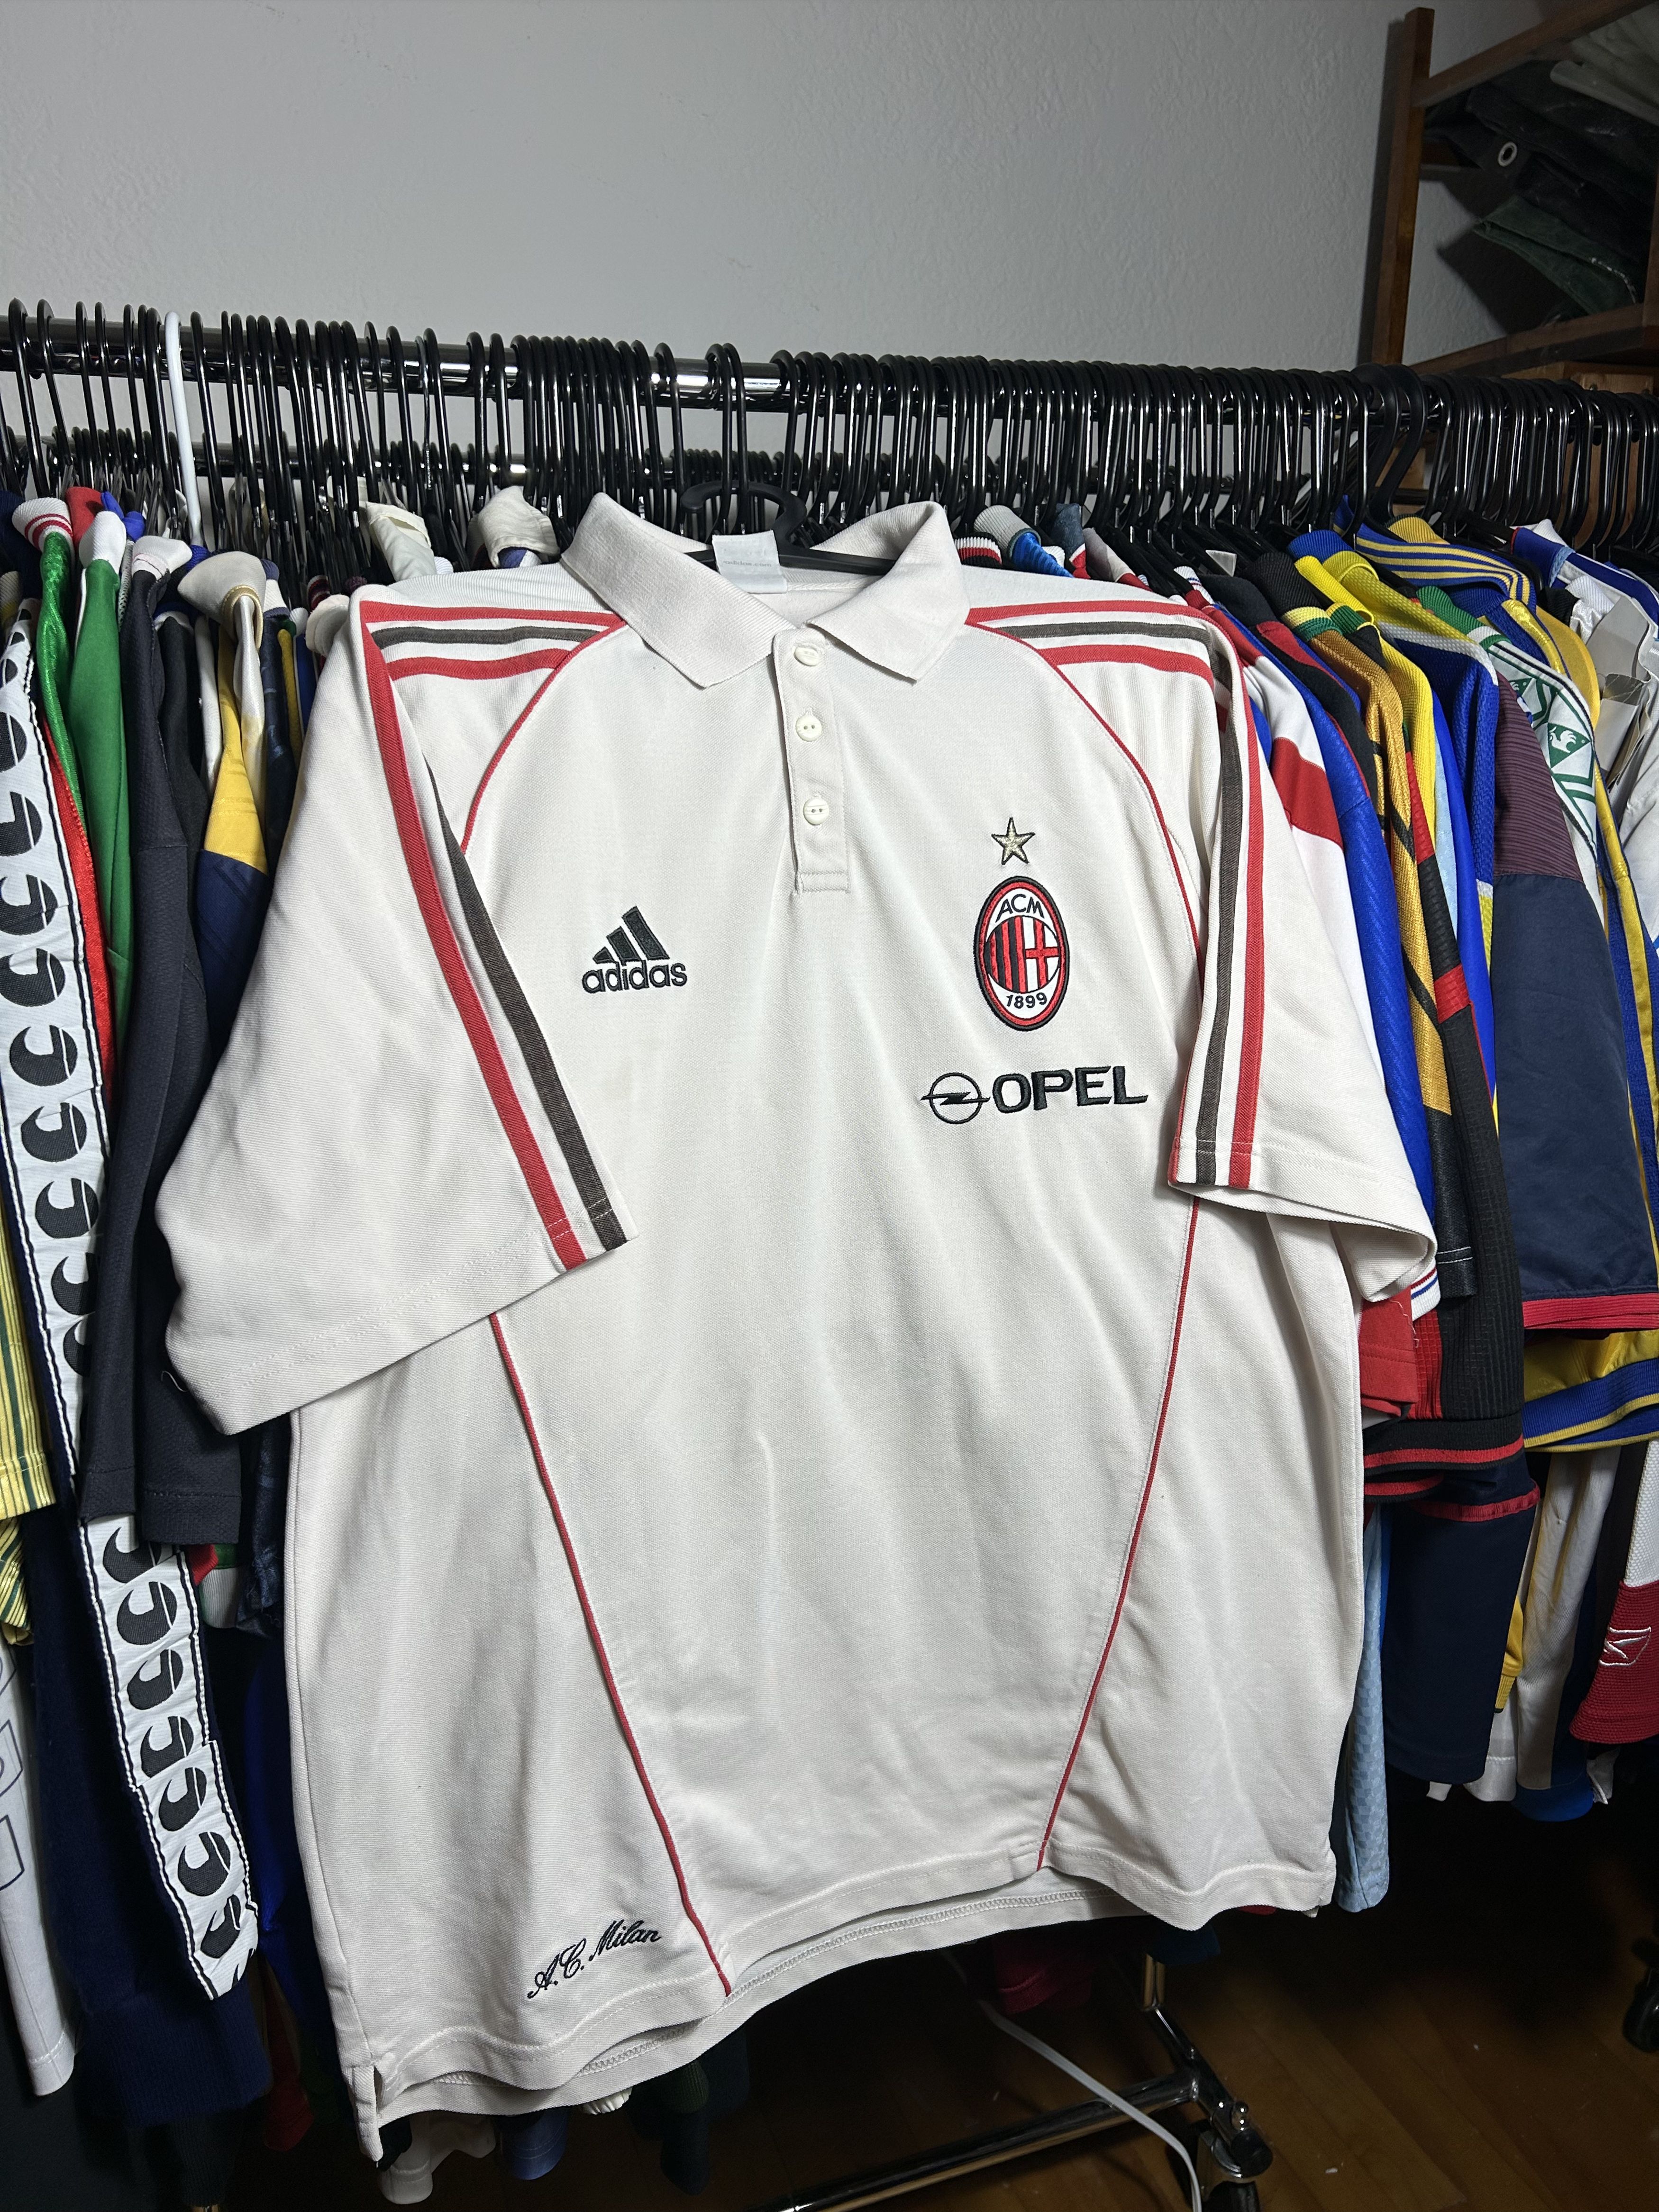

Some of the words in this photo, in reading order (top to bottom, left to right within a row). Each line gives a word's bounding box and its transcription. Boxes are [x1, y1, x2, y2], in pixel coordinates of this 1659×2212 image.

[995, 894, 1045, 923] ACM
[582, 960, 688, 994] adidas
[1006, 992, 1048, 1009] 1899
[992, 1066, 1148, 1113] OPEL
[588, 1919, 662, 1961] Milan
